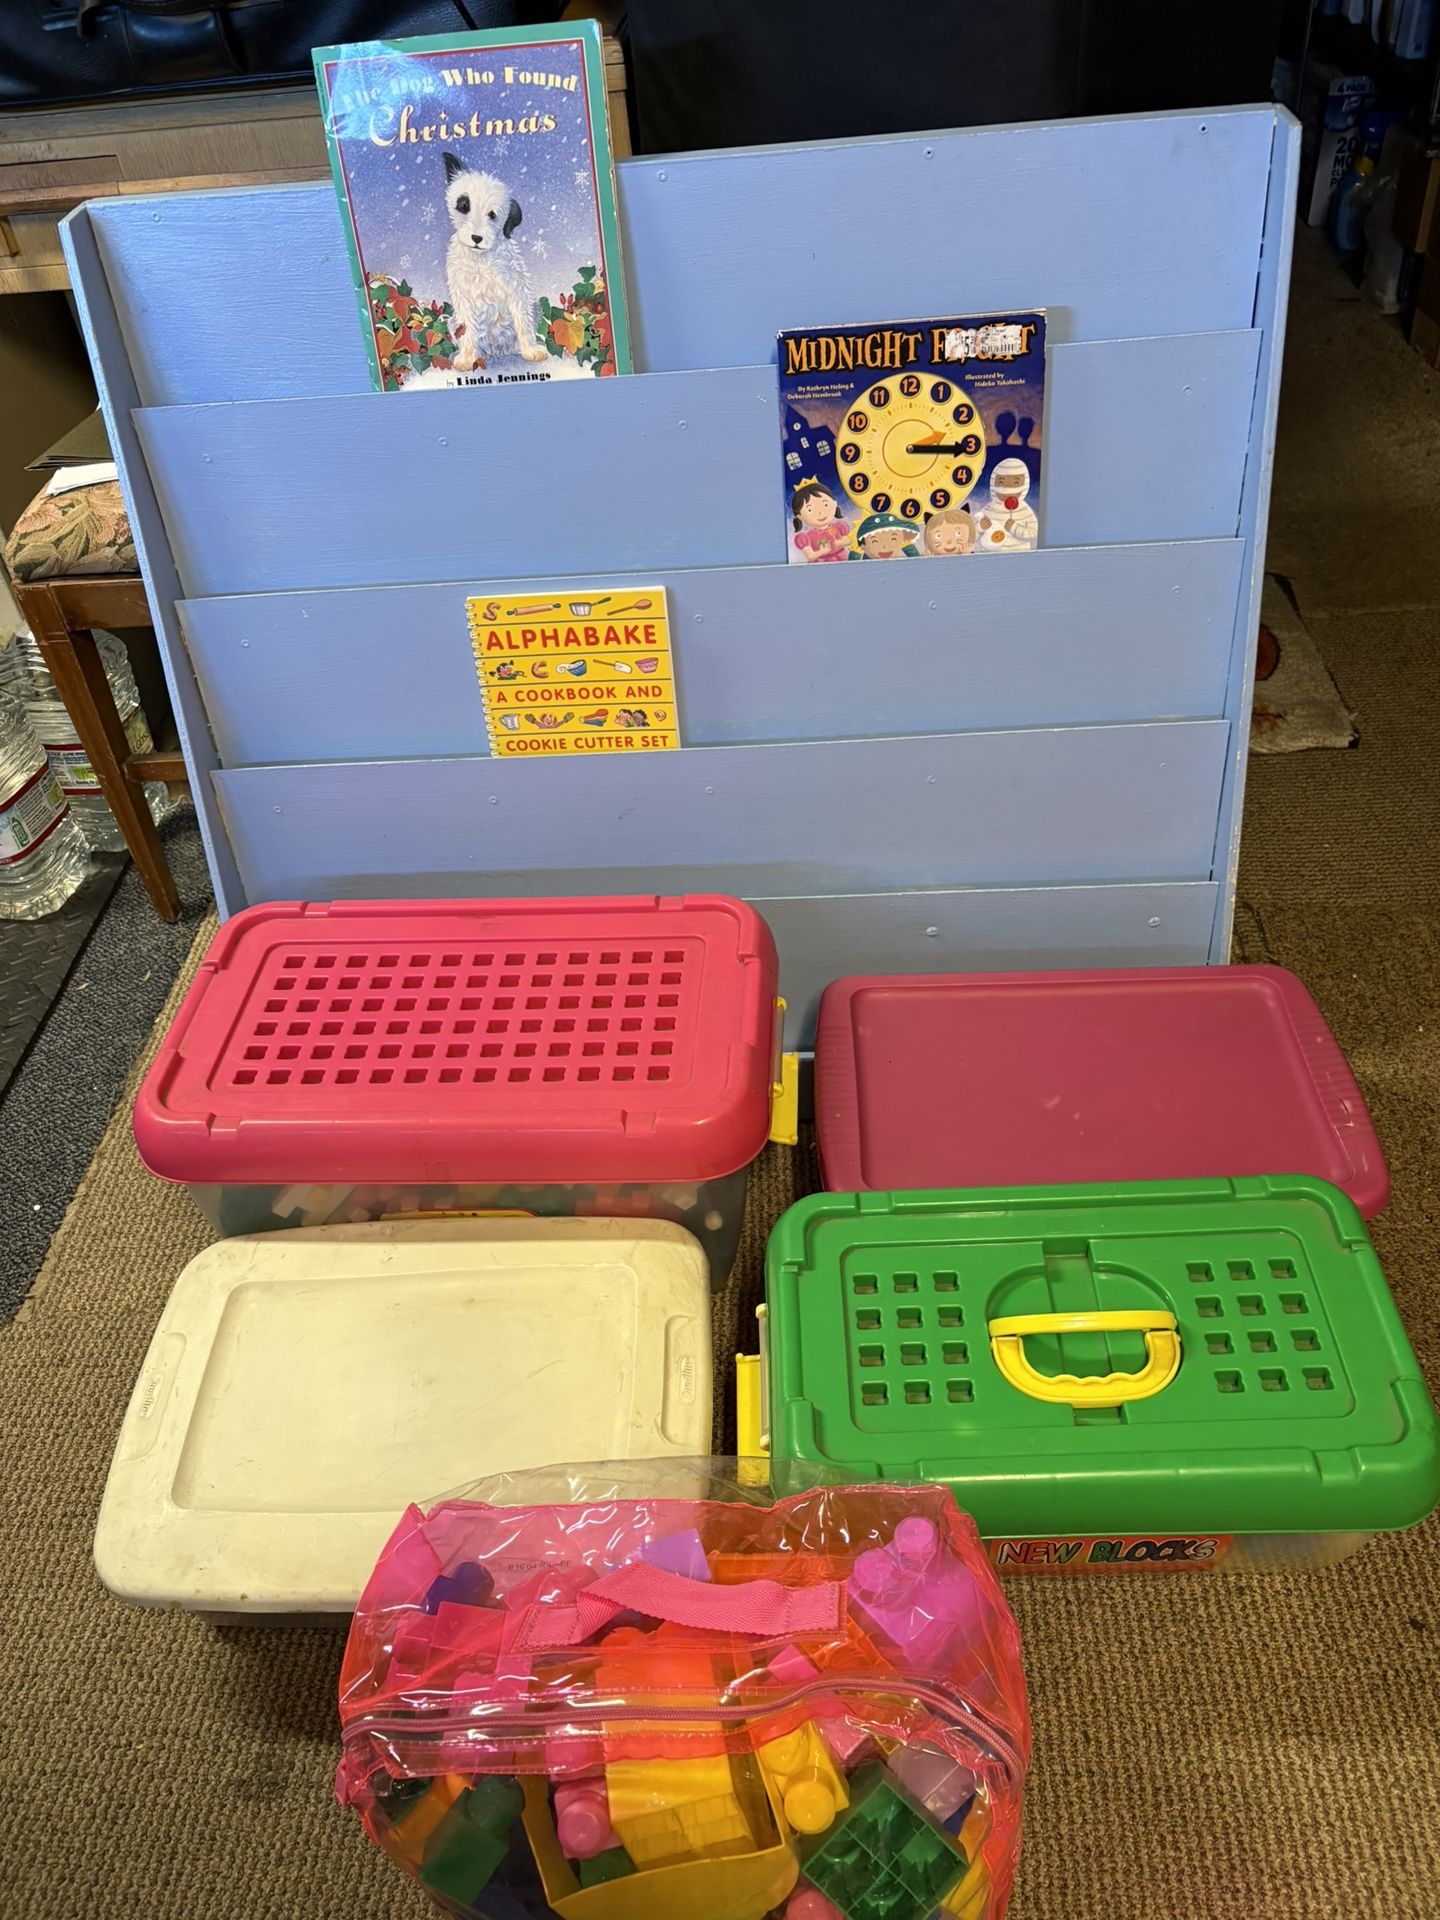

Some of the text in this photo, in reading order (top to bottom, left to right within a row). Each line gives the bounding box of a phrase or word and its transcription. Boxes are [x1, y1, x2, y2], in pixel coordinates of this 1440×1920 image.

[390, 74, 434, 96] Dog
[441, 66, 495, 88] Who
[504, 66, 579, 93] Found
[369, 104, 559, 148] Christmas
[785, 330, 922, 374] MIDNIGHT
[457, 374, 493, 387] Linda
[496, 371, 552, 383] Jennings
[997, 372, 1005, 380] by
[797, 385, 806, 393] By
[901, 378, 918, 394] 12
[936, 386, 945, 400] 1
[872, 390, 886, 404] 11
[958, 407, 969, 421] 2
[849, 415, 867, 429] 10
[966, 438, 976, 452] 3
[845, 447, 855, 461] 9
[854, 476, 864, 490] 8
[956, 469, 967, 483] 4
[876, 496, 887, 510] 7
[935, 492, 945, 506] 5
[905, 502, 915, 516] 6
[486, 624, 657, 651] ALPHABAKE
[496, 685, 663, 704] A COOKBOOK AND
[505, 735, 669, 752] COOKIE CUTTER SET
[997, 1538, 1220, 1566] NEW BLOCKS
